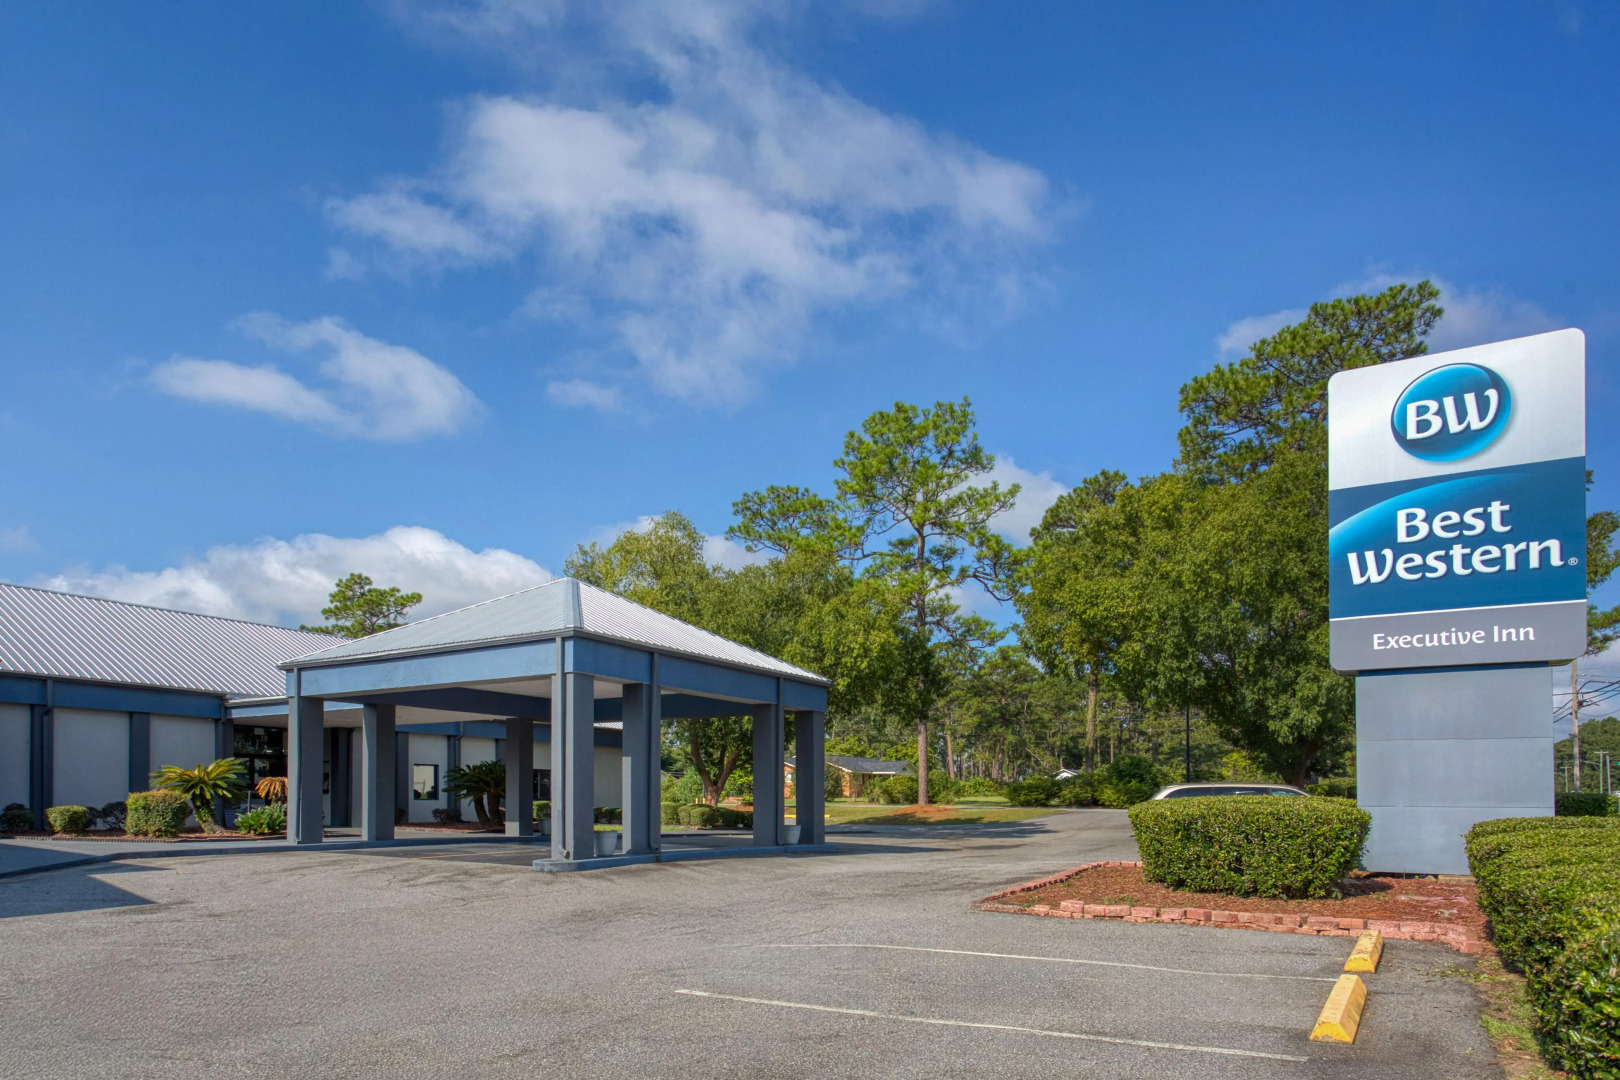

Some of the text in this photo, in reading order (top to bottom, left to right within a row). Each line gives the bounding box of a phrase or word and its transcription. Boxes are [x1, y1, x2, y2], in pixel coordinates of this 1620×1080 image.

[1406, 388, 1499, 440] BW
[1397, 501, 1512, 543] Best
[1373, 625, 1535, 650] Executive Inn
